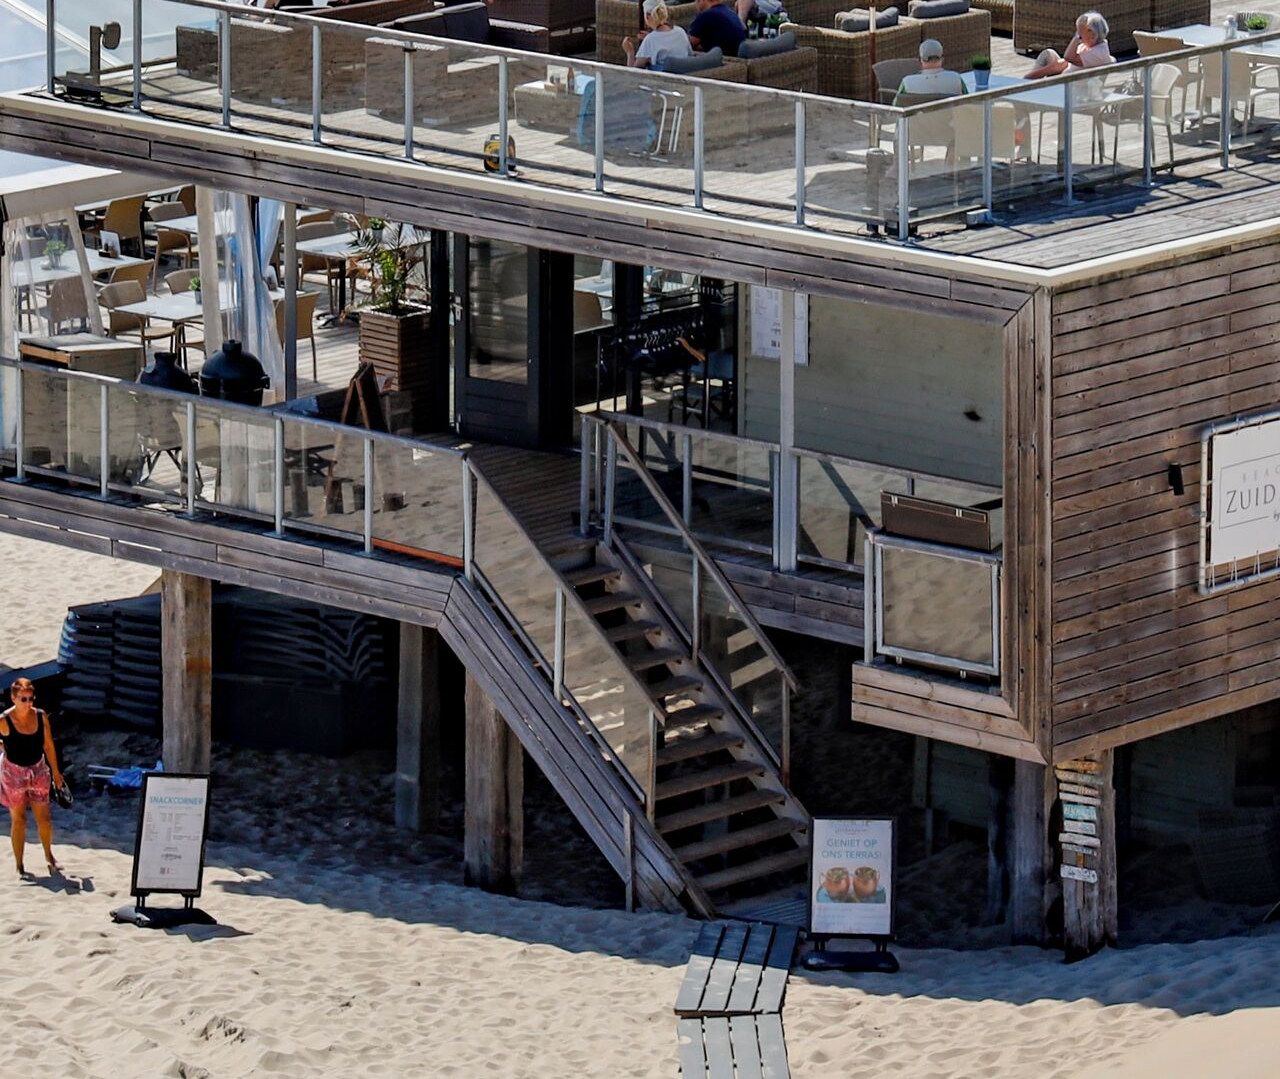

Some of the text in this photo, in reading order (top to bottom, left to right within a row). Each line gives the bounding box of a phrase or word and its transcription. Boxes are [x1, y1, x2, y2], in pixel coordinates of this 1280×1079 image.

[1272, 510, 1280, 521] by
[826, 838, 878, 848] GENIET OP
[821, 849, 842, 859] ONS
